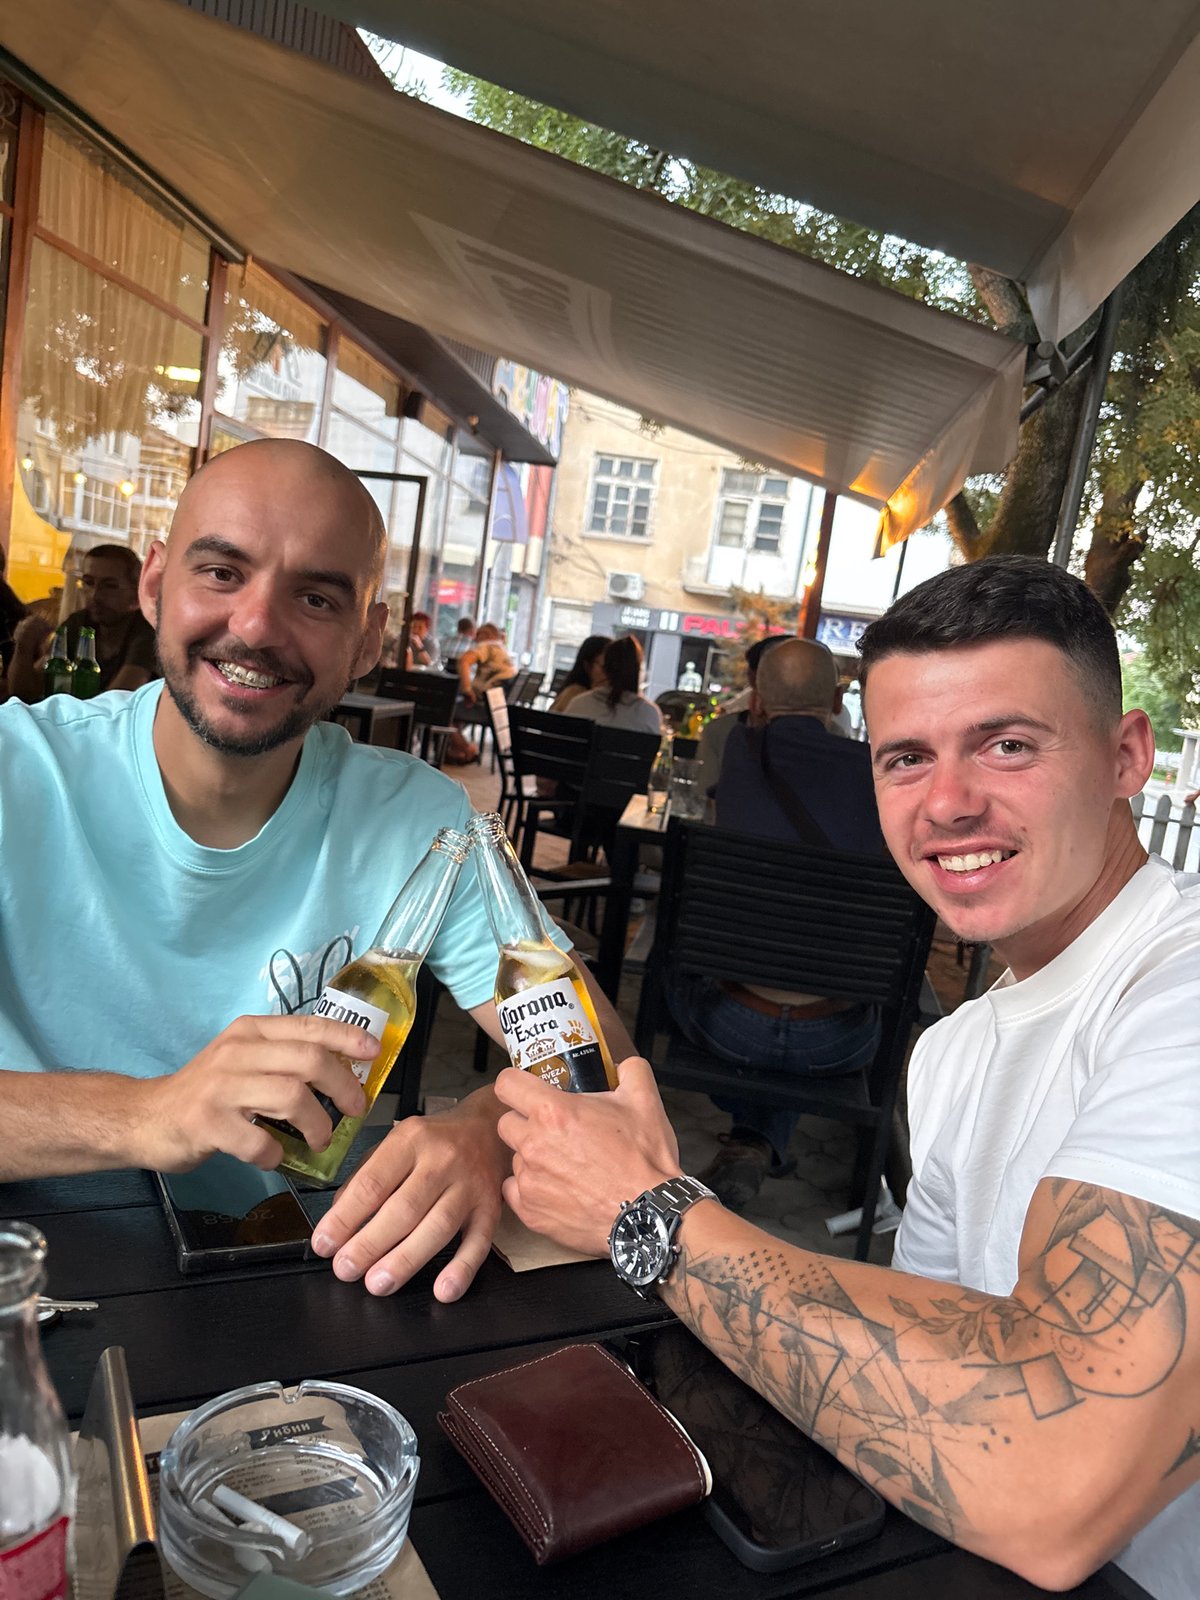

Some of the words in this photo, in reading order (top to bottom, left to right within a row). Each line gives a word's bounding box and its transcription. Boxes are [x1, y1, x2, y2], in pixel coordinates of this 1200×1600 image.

[500, 990, 569, 1034] Corona
[515, 1017, 560, 1043] Extra
[539, 1066, 567, 1081] RVEZA
[541, 1064, 552, 1072] LA
